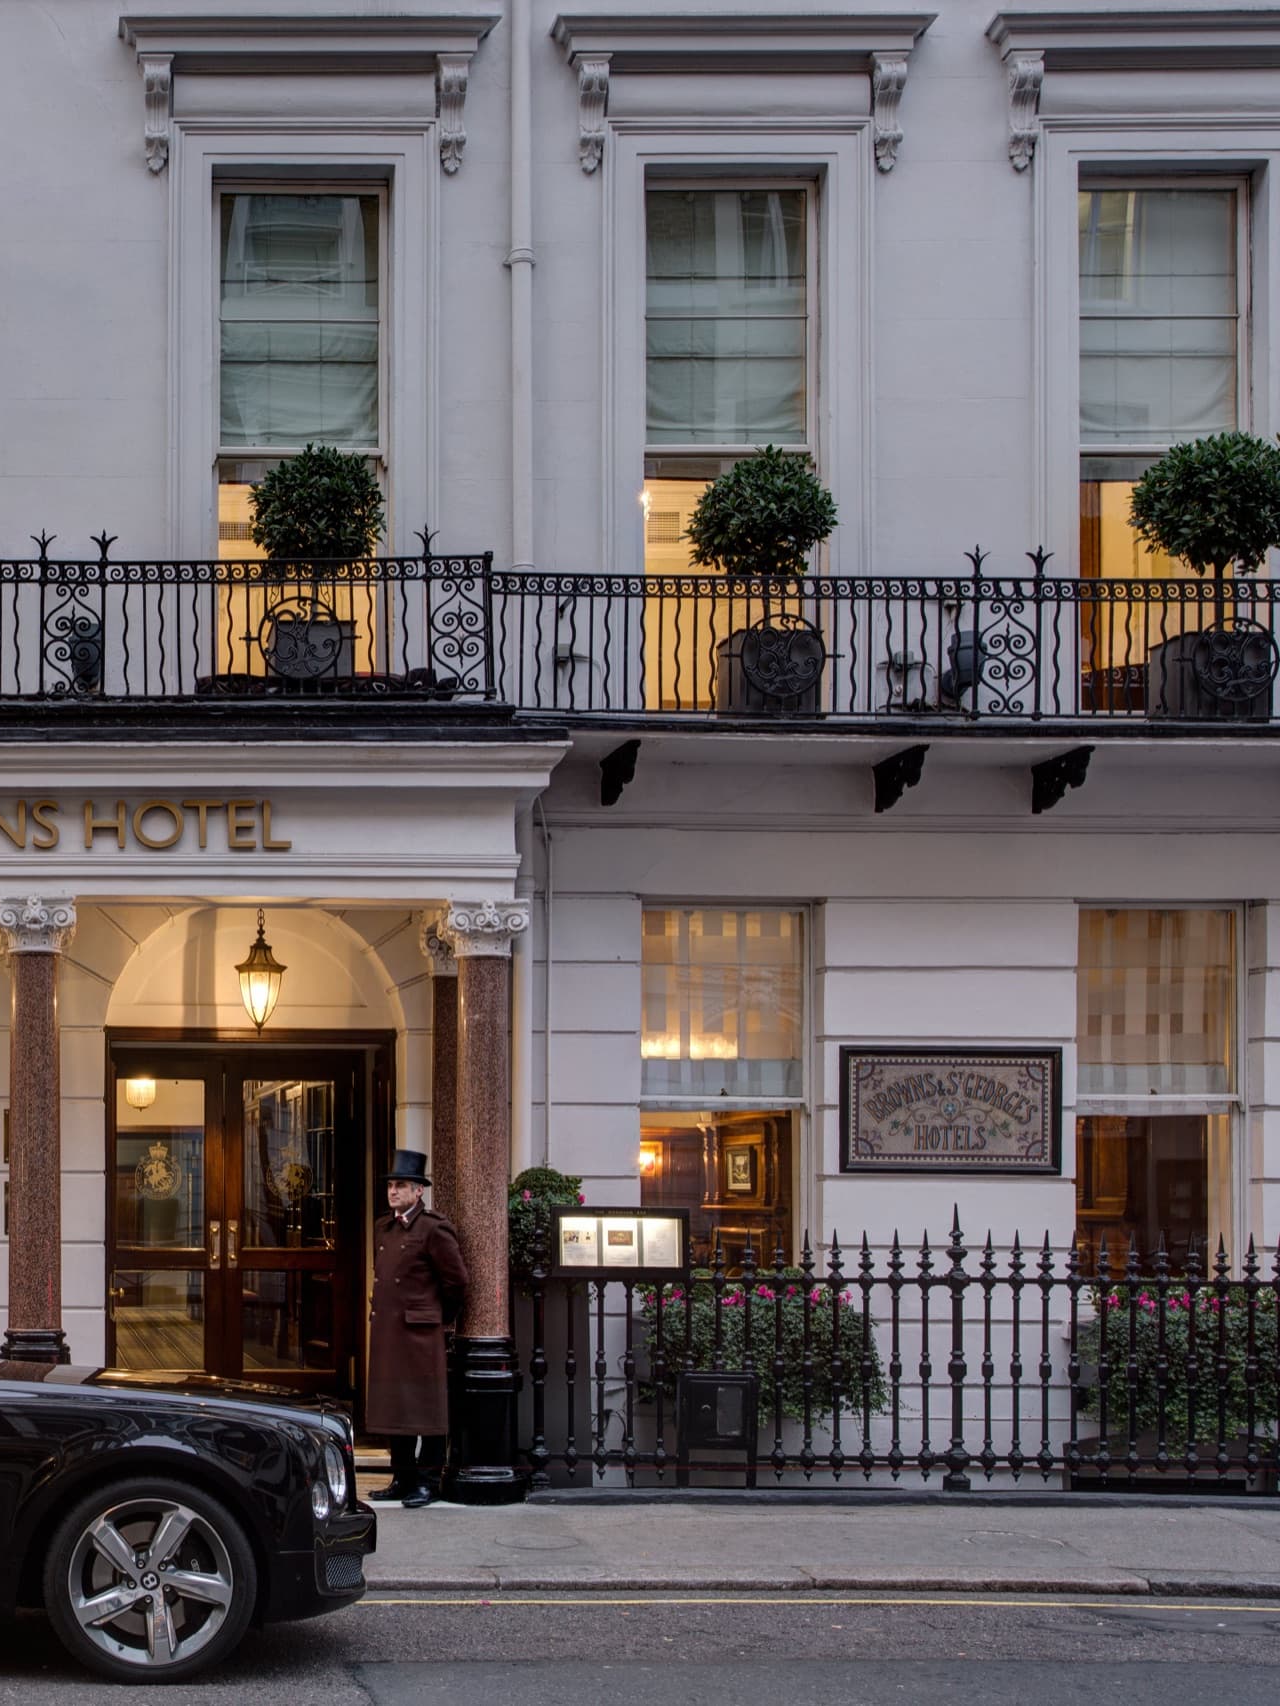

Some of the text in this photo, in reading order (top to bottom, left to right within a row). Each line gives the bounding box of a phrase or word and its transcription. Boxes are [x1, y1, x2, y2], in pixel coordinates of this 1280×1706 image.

[83, 799, 293, 850] HOTEL
[863, 1073, 937, 1124] BROWNS
[913, 1125, 987, 1150] HOTELS
